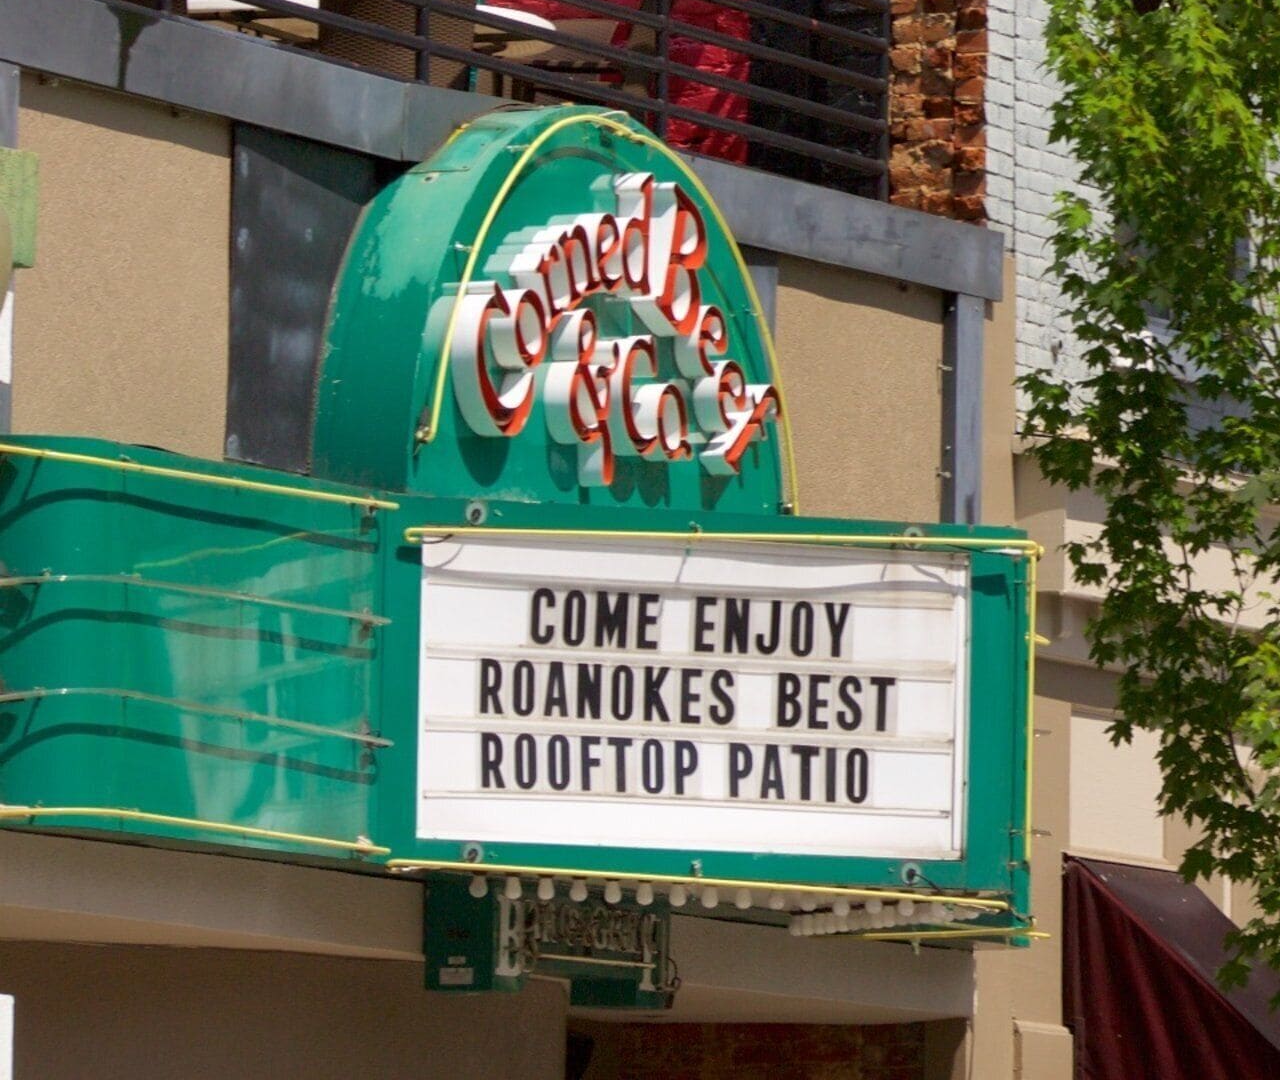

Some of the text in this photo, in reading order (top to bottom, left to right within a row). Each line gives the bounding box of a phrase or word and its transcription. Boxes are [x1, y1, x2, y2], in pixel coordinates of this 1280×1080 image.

[530, 587, 852, 659] COME ENJOY
[479, 658, 898, 732] ROANOKES BEST
[481, 733, 870, 805] ROOFTOP PATIO
